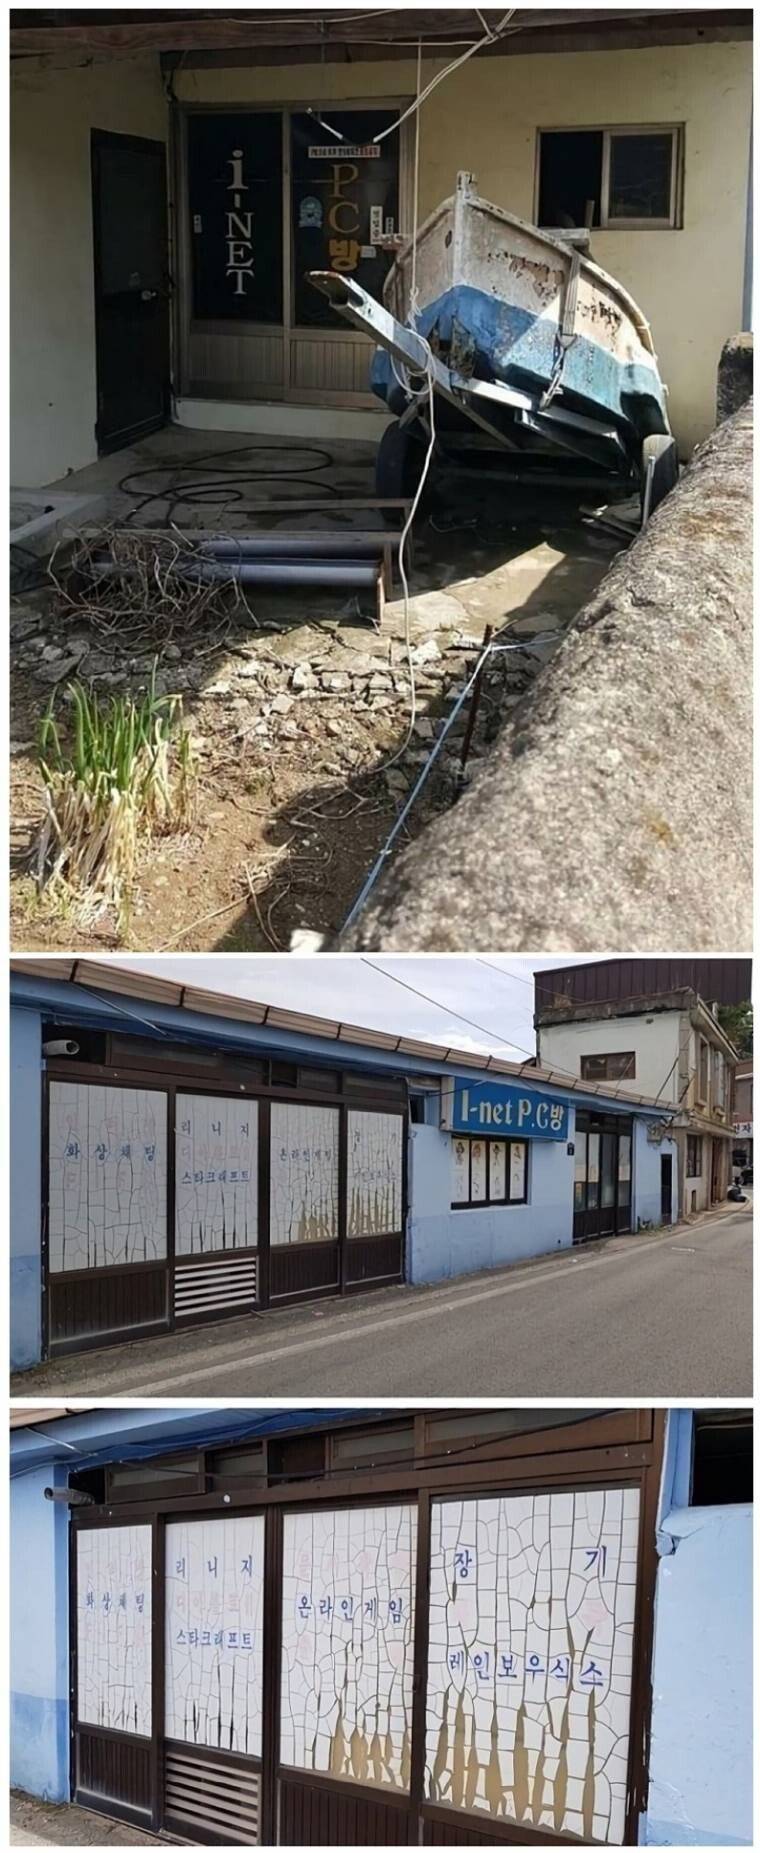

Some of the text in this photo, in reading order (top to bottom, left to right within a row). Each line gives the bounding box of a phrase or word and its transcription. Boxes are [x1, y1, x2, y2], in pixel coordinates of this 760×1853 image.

[225, 149, 255, 295] i-NET
[329, 163, 361, 271] PC방
[181, 1120, 250, 1137] 리니지
[175, 1554, 253, 1578] 리니지
[298, 1593, 404, 1623] 온라인게임
[176, 1630, 253, 1650] 스타크래프트
